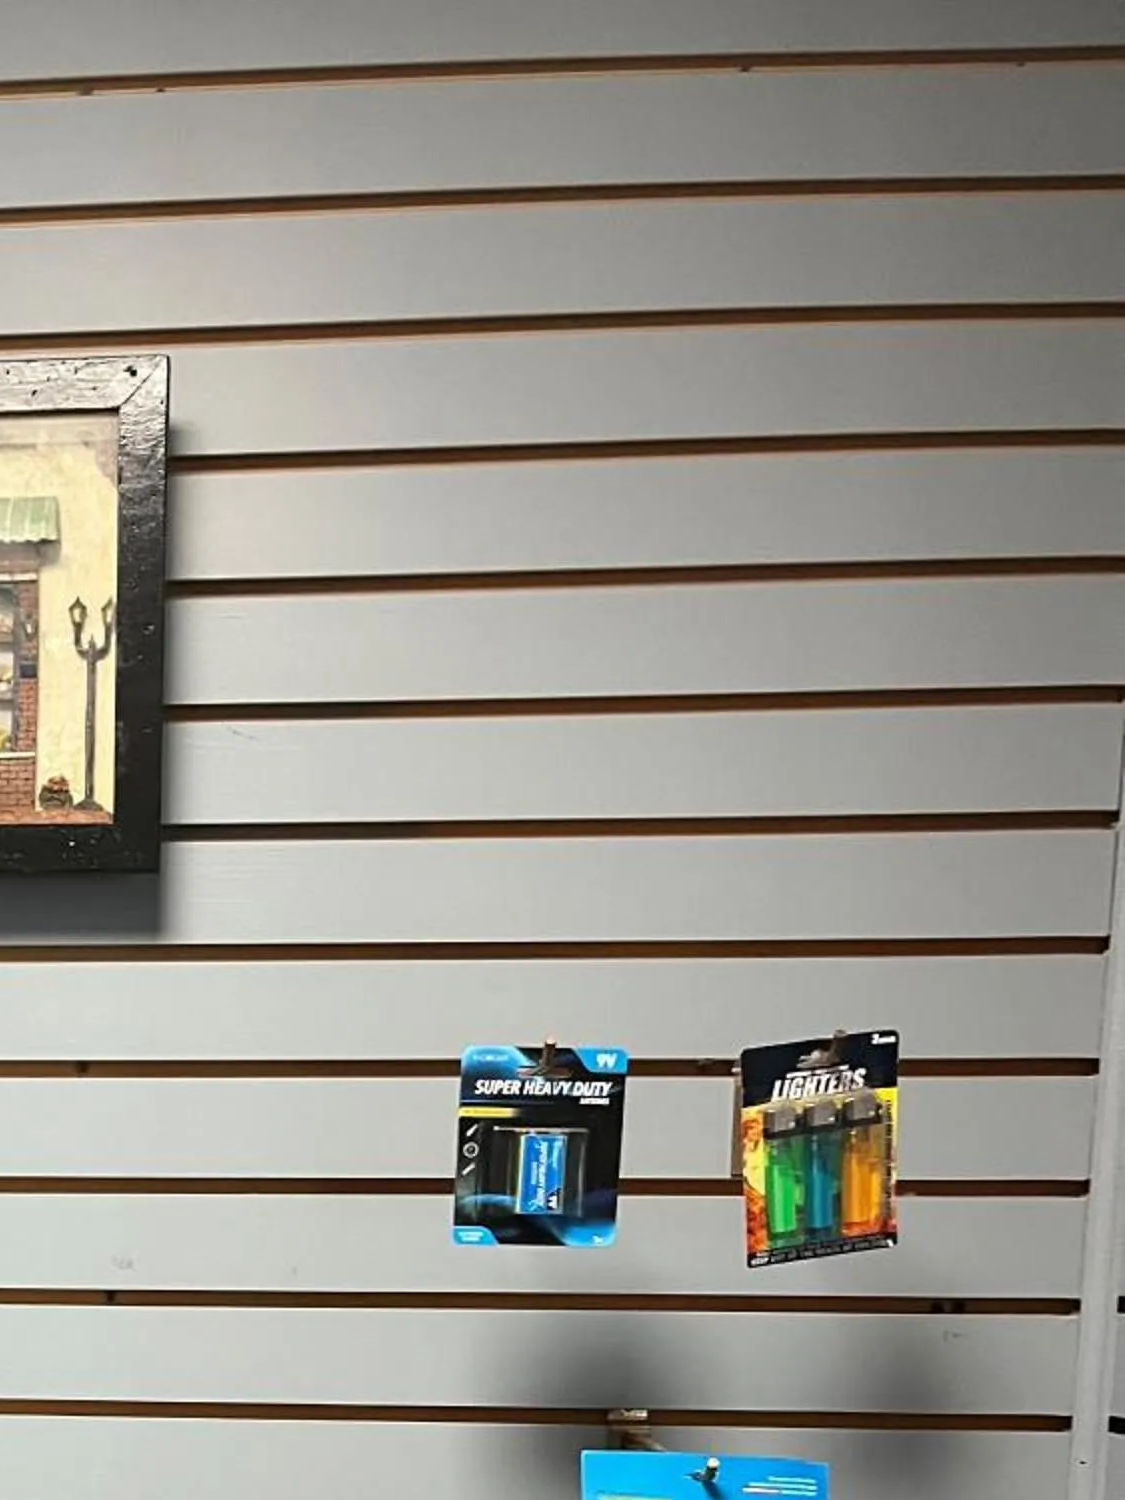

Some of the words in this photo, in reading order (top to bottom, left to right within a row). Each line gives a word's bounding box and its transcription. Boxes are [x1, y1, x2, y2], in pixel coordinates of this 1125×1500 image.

[596, 1054, 618, 1068] 9V
[475, 1080, 521, 1096] SUPER
[522, 1081, 573, 1097] HEAVY
[572, 1082, 612, 1097] DUTY
[772, 1067, 867, 1102] LIGHTERS
